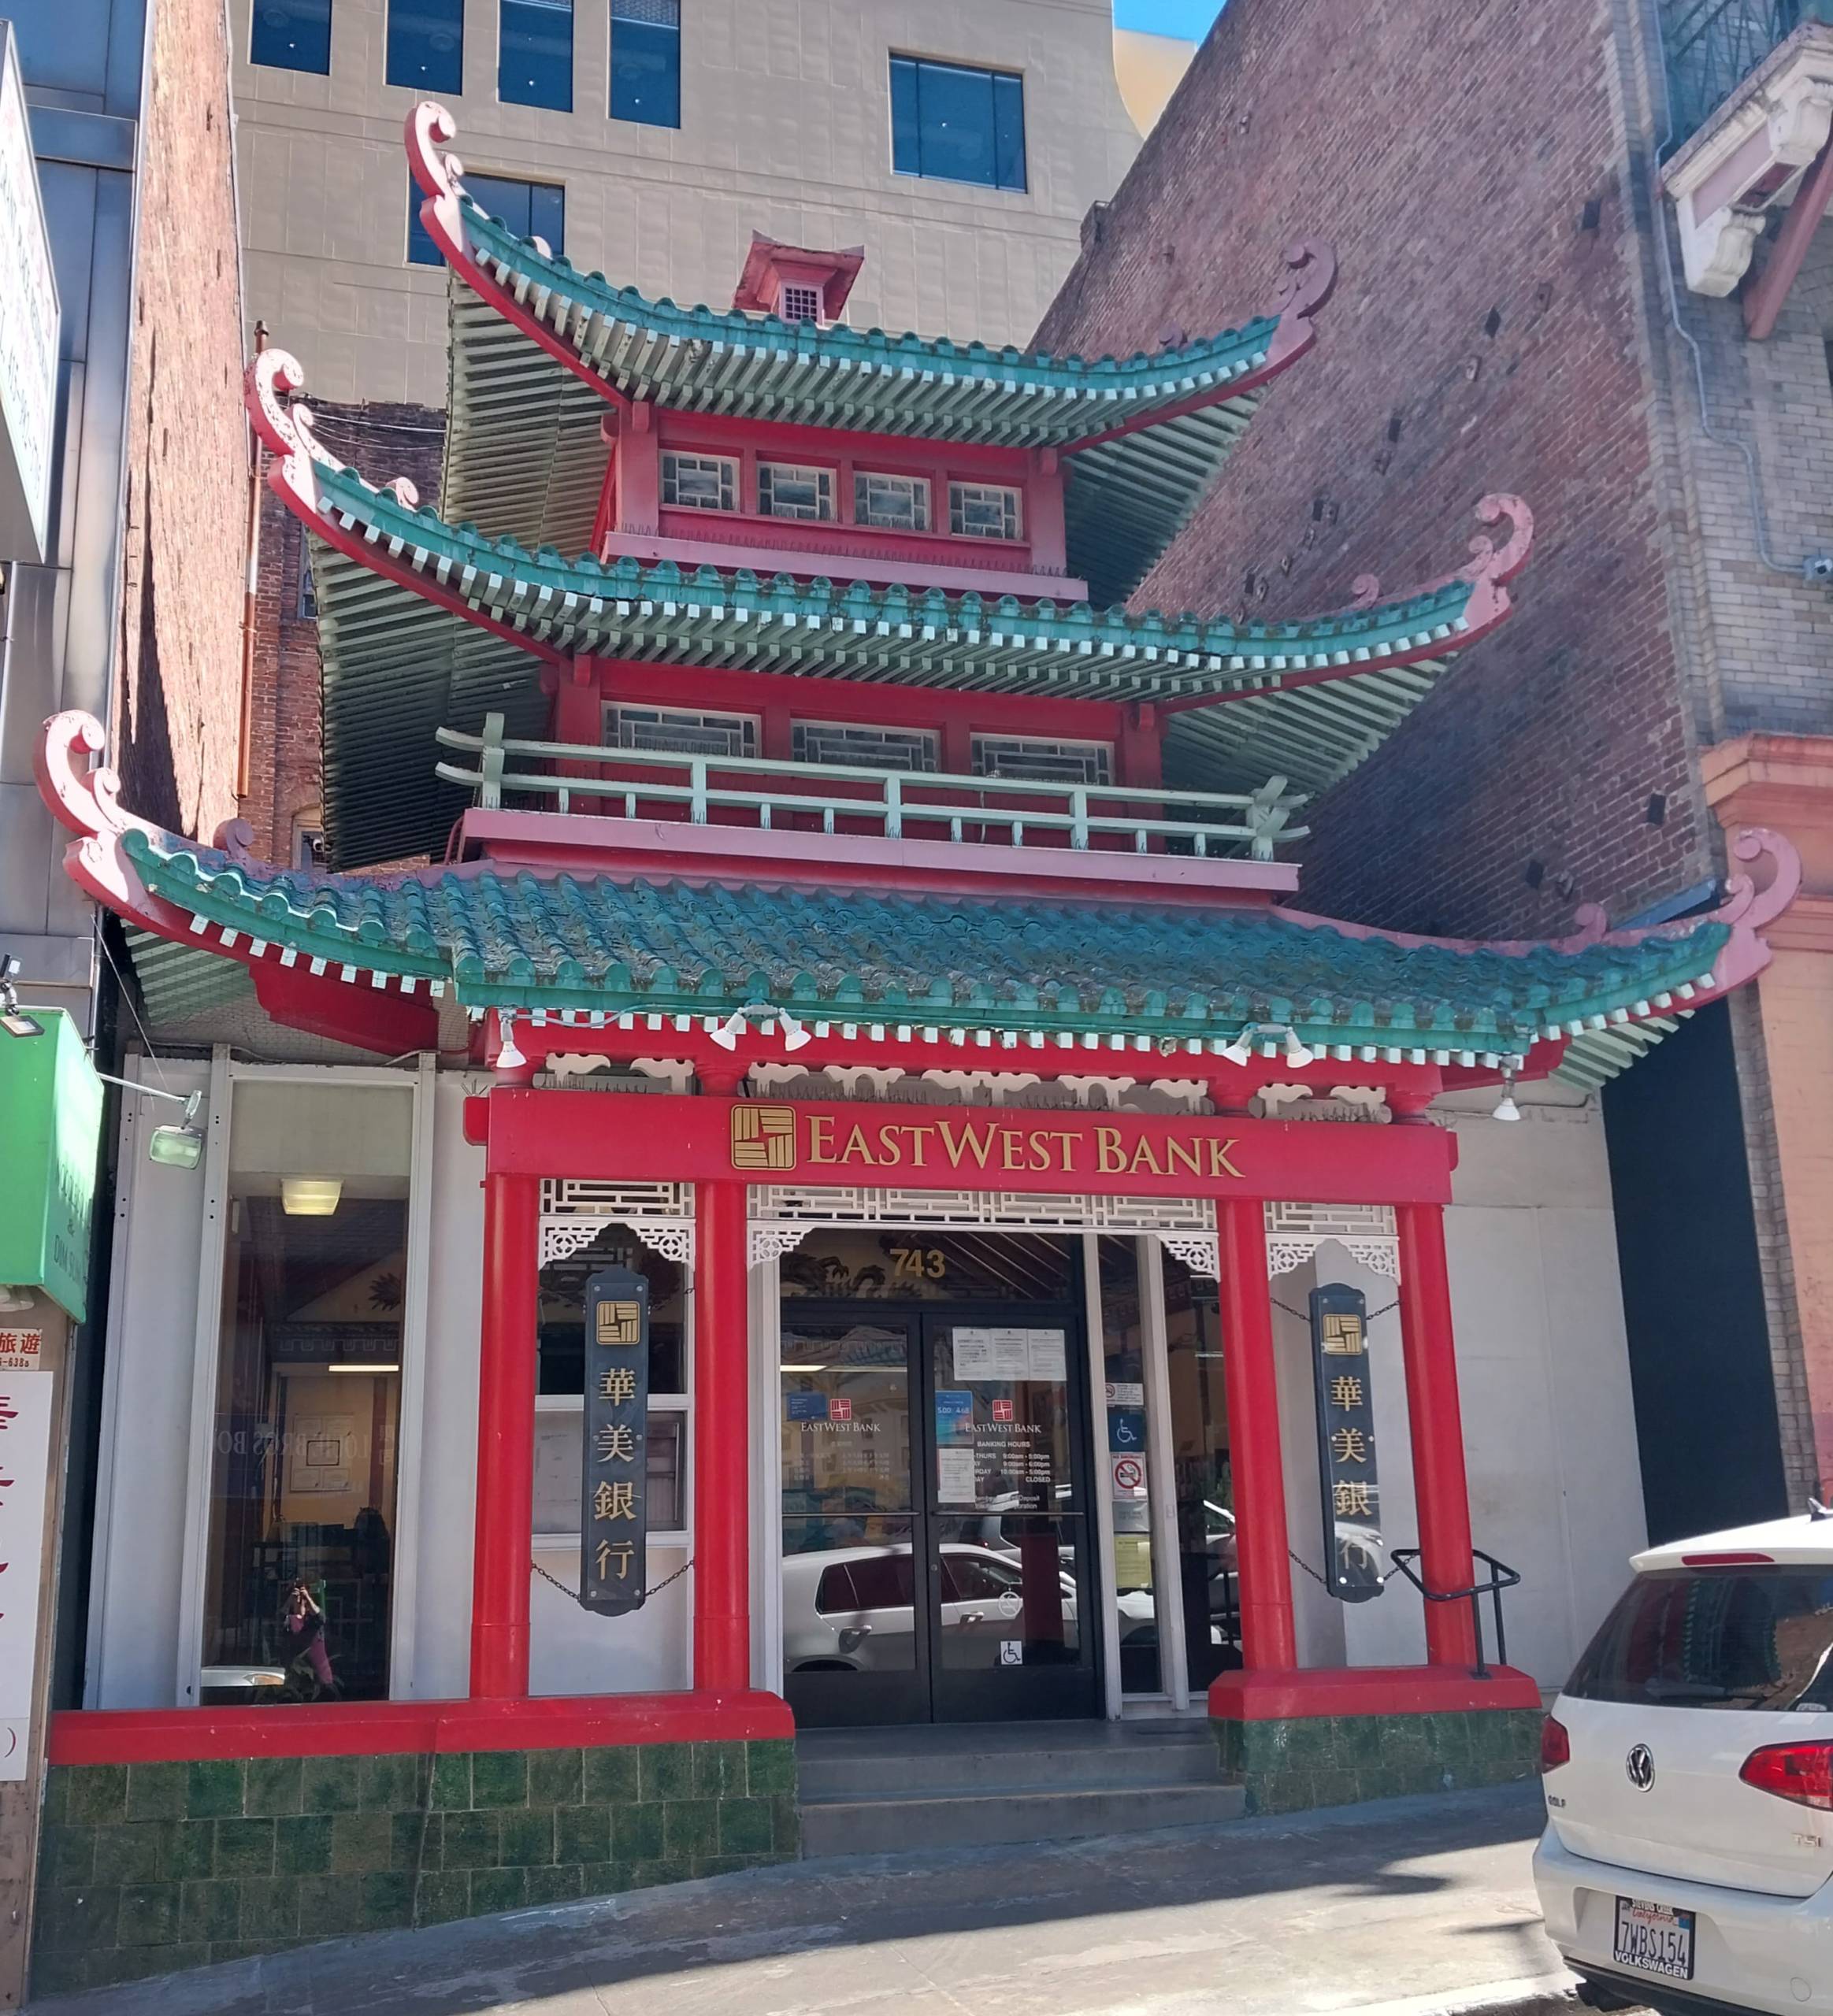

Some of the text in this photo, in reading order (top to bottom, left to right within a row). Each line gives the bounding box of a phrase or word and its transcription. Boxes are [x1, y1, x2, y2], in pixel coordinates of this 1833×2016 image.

[1093, 1127, 1246, 1177] BANK
[889, 1248, 945, 1278] 743
[853, 1422, 881, 1432] BANK
[1015, 1423, 1041, 1433] BANK
[593, 1368, 636, 1580] 華美銀行
[1331, 1377, 1373, 1569] 華美銀行
[1622, 1922, 1686, 1965] 7WBS154
[1615, 1951, 1688, 1979] VOLKSWAGEN
